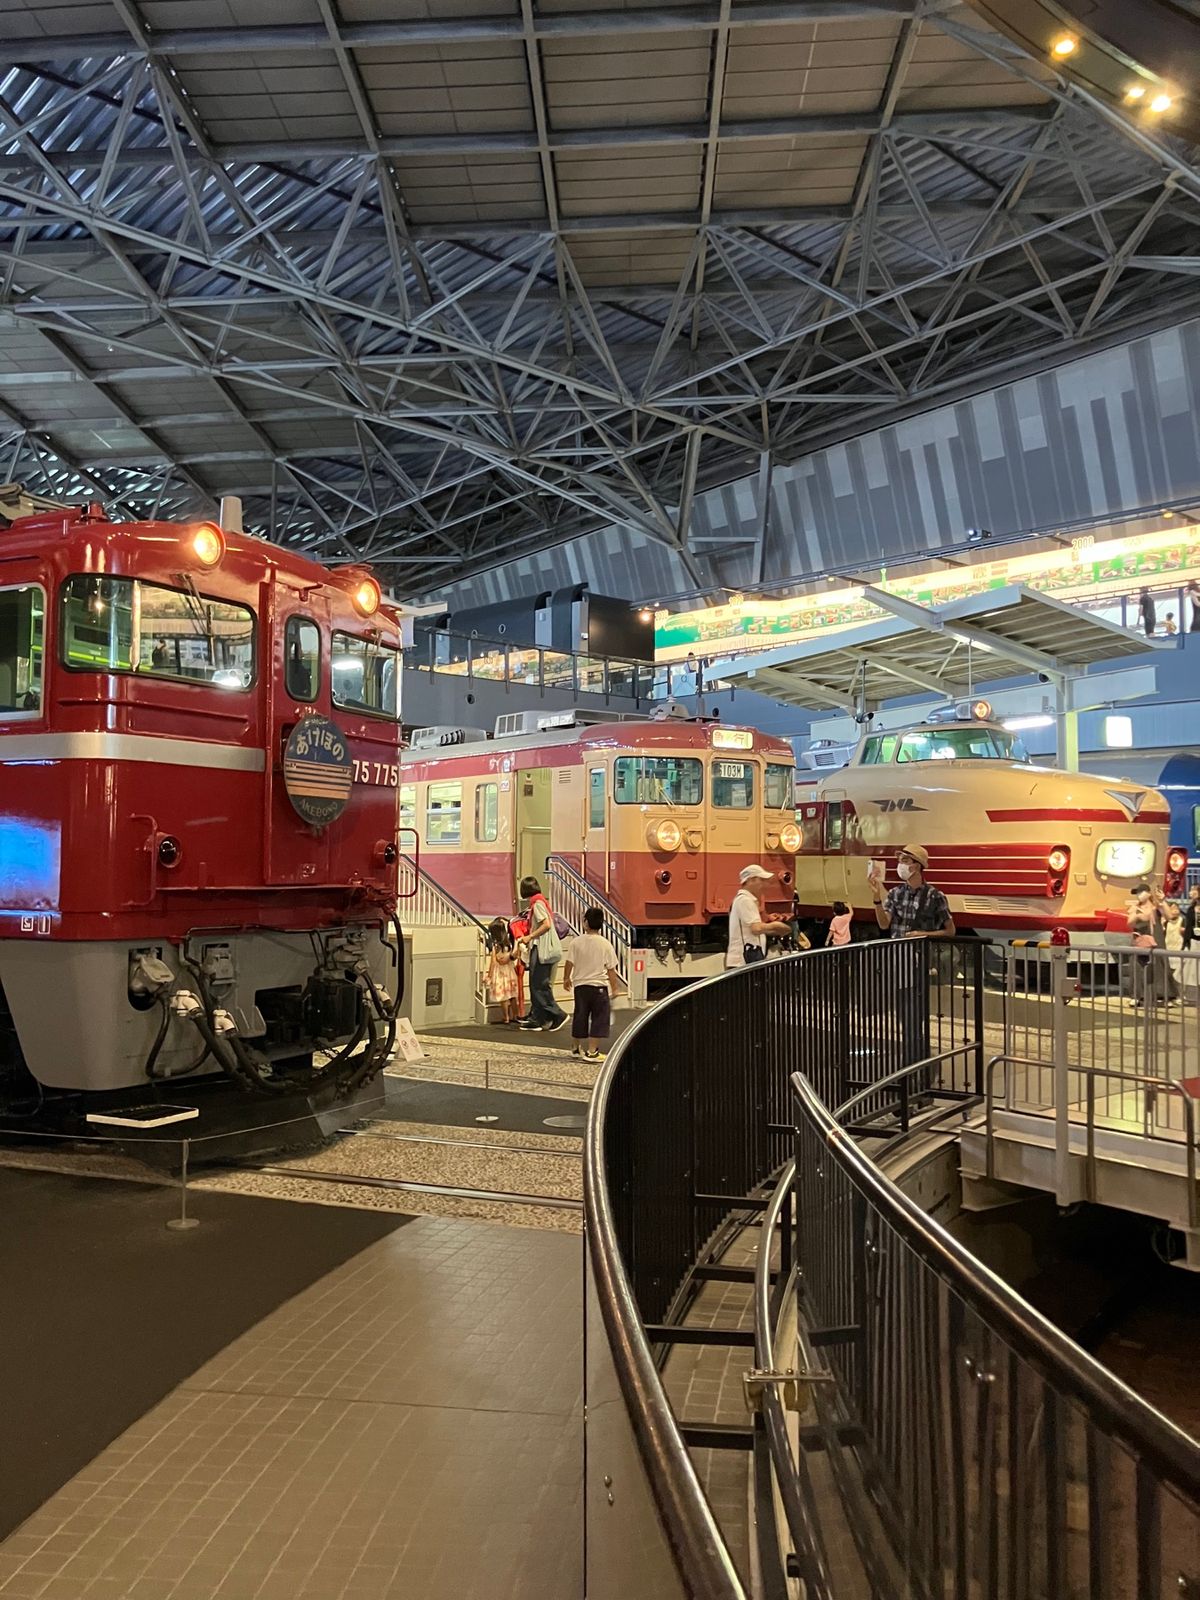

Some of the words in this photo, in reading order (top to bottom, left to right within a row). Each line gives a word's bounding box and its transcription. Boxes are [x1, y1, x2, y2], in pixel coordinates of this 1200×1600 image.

[296, 728, 344, 760] あけぼの
[352, 759, 370, 783] 75
[373, 763, 398, 787] 775
[299, 799, 338, 817] AKEBONO
